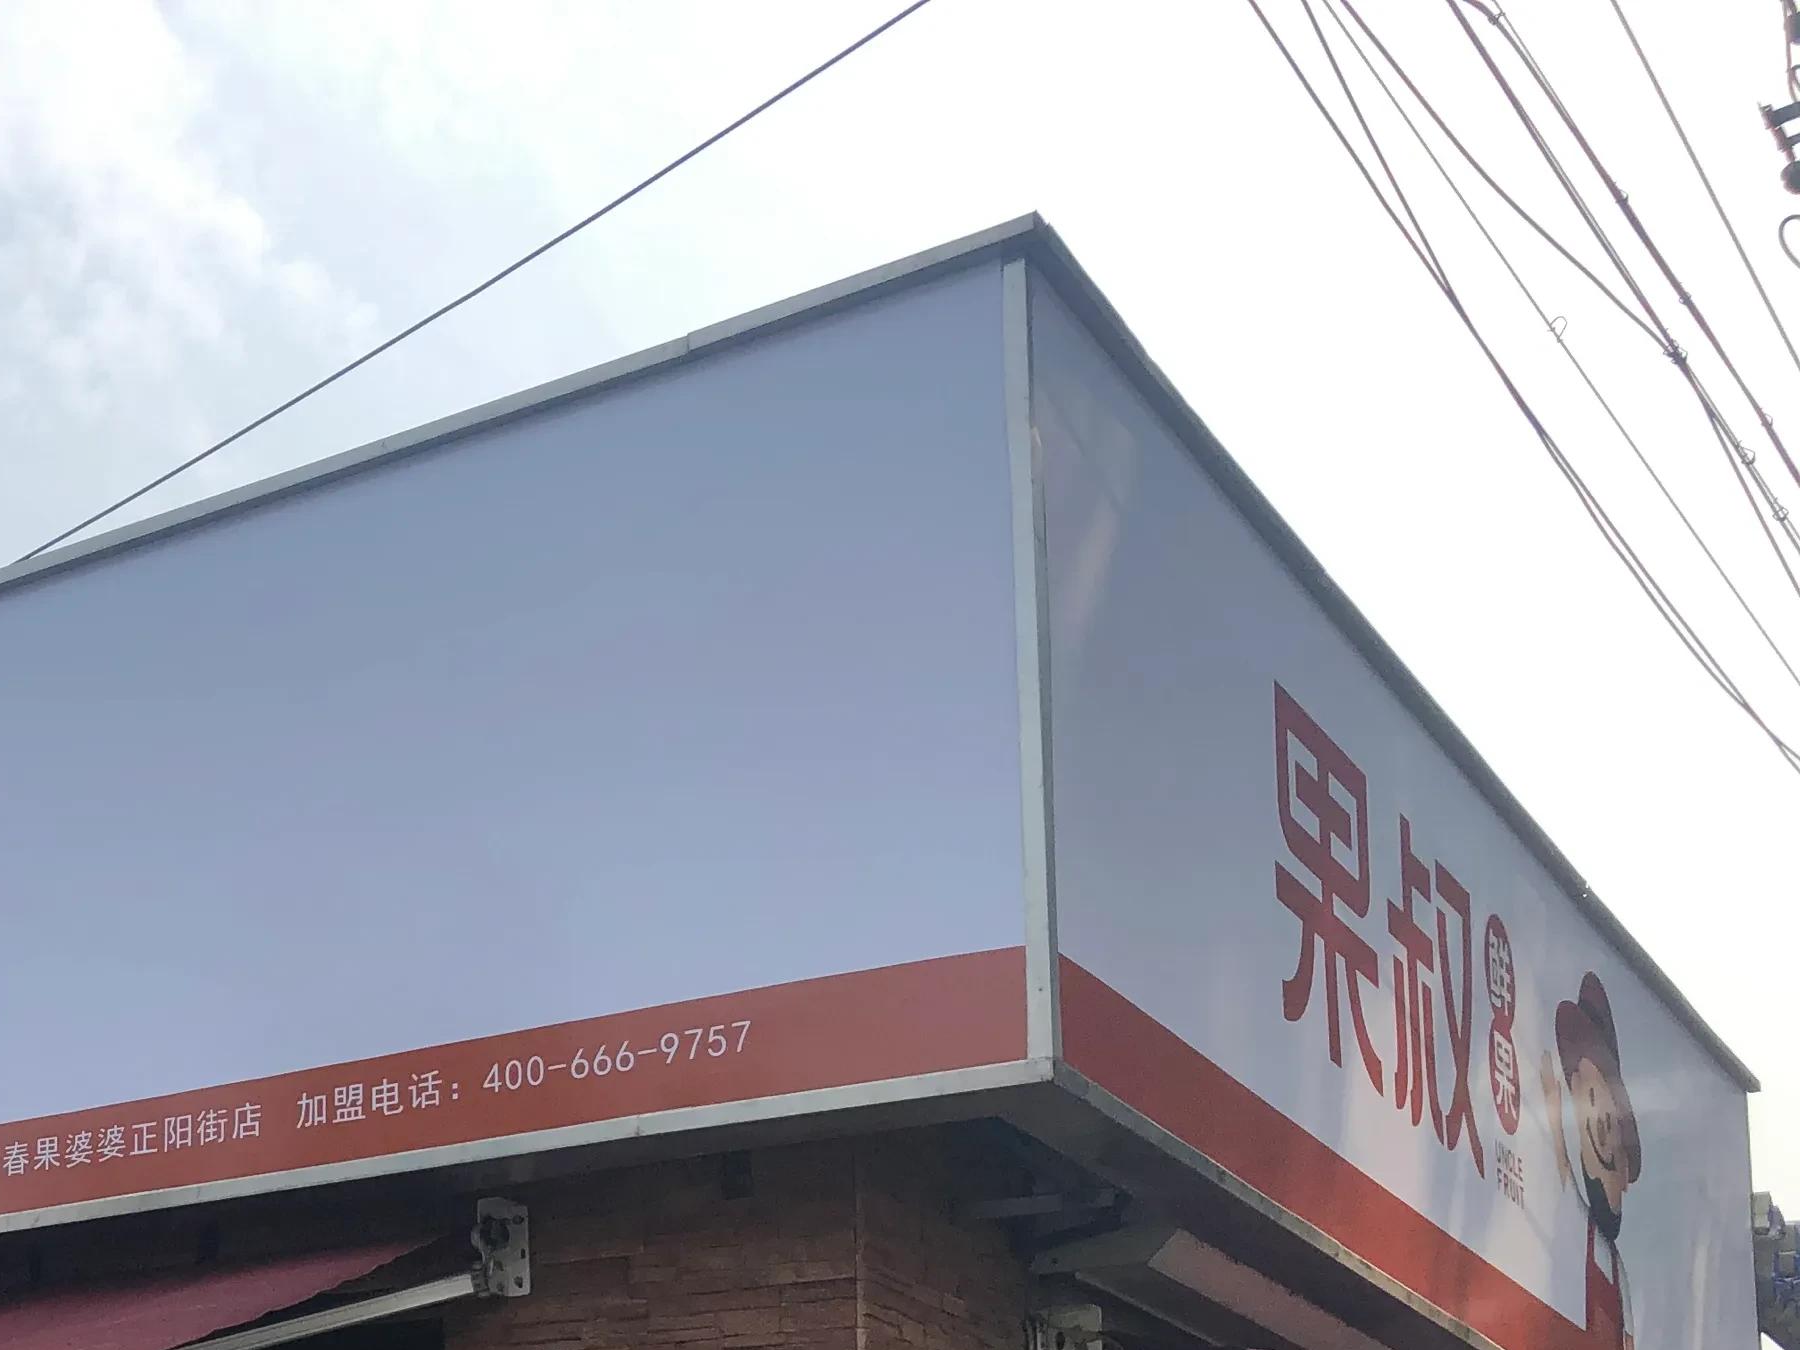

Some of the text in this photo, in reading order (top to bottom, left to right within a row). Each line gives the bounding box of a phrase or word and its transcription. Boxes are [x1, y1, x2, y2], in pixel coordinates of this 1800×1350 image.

[1273, 678, 1486, 1181] 果叔
[482, 1019, 752, 1094] 400-666-9757
[1488, 927, 1517, 1121] 鲜果
[1496, 1168, 1525, 1210] FRUIT
